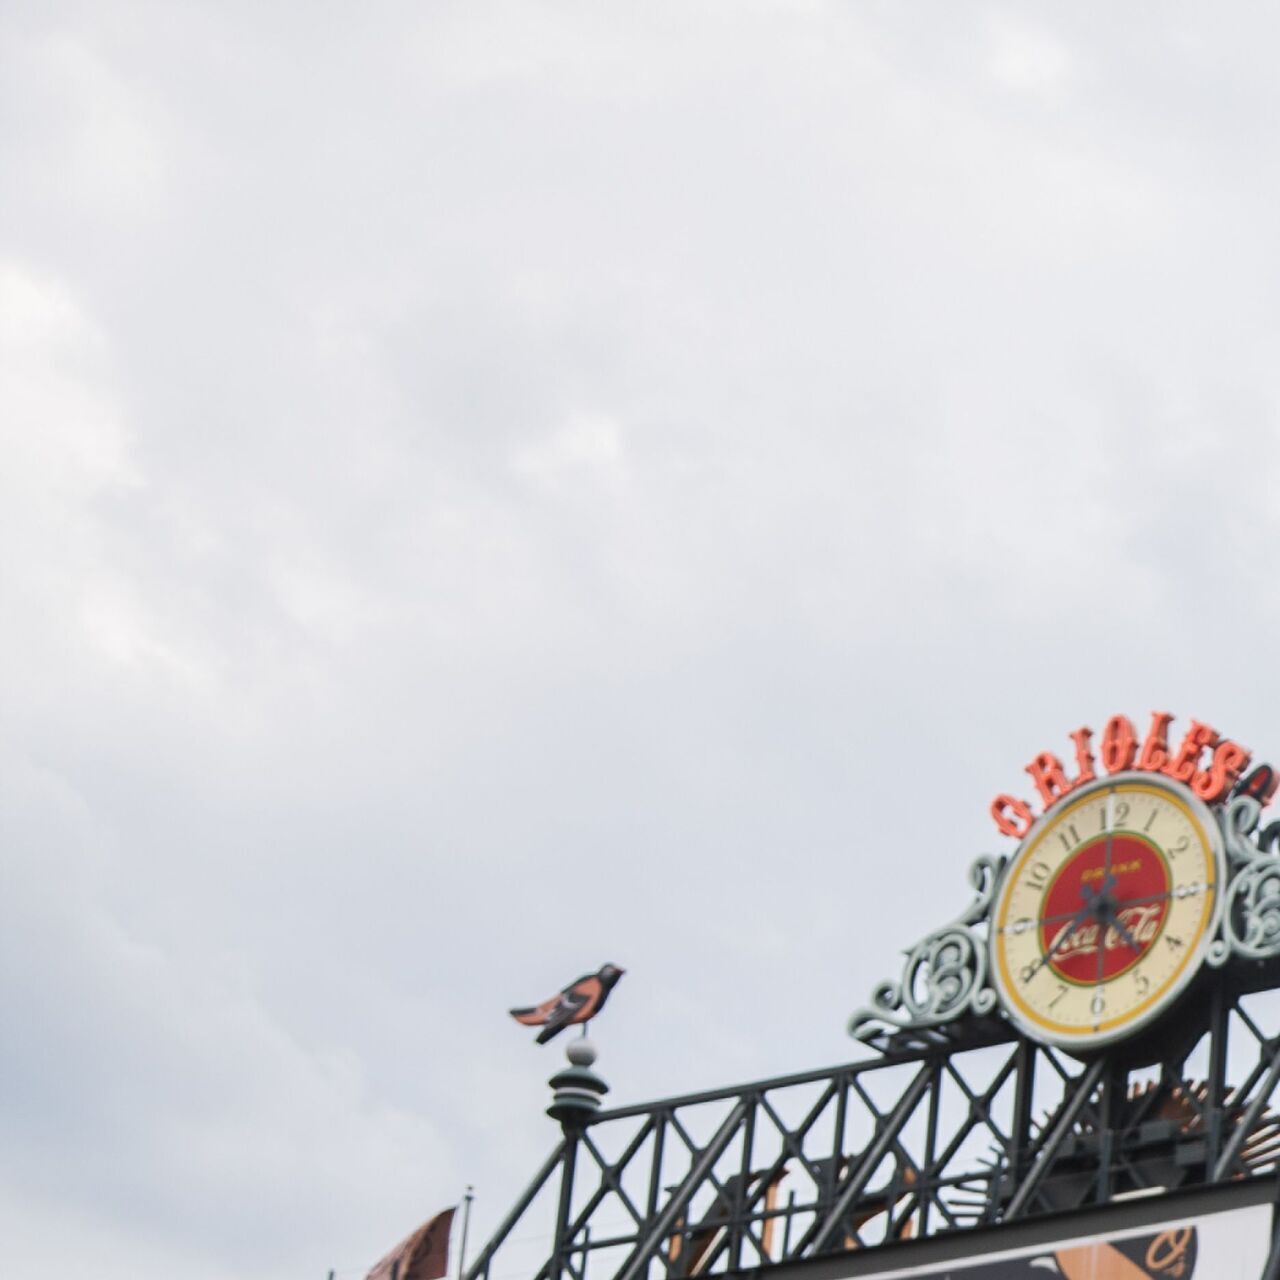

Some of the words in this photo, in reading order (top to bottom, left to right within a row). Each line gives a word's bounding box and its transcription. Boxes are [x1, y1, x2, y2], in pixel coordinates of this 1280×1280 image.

[990, 711, 1252, 840] ORIOLES
[1058, 825, 1081, 851] 11
[1167, 836, 1189, 860] 2
[1025, 862, 1052, 892] 10
[1165, 934, 1183, 952] 4
[1048, 986, 1069, 1008] 7
